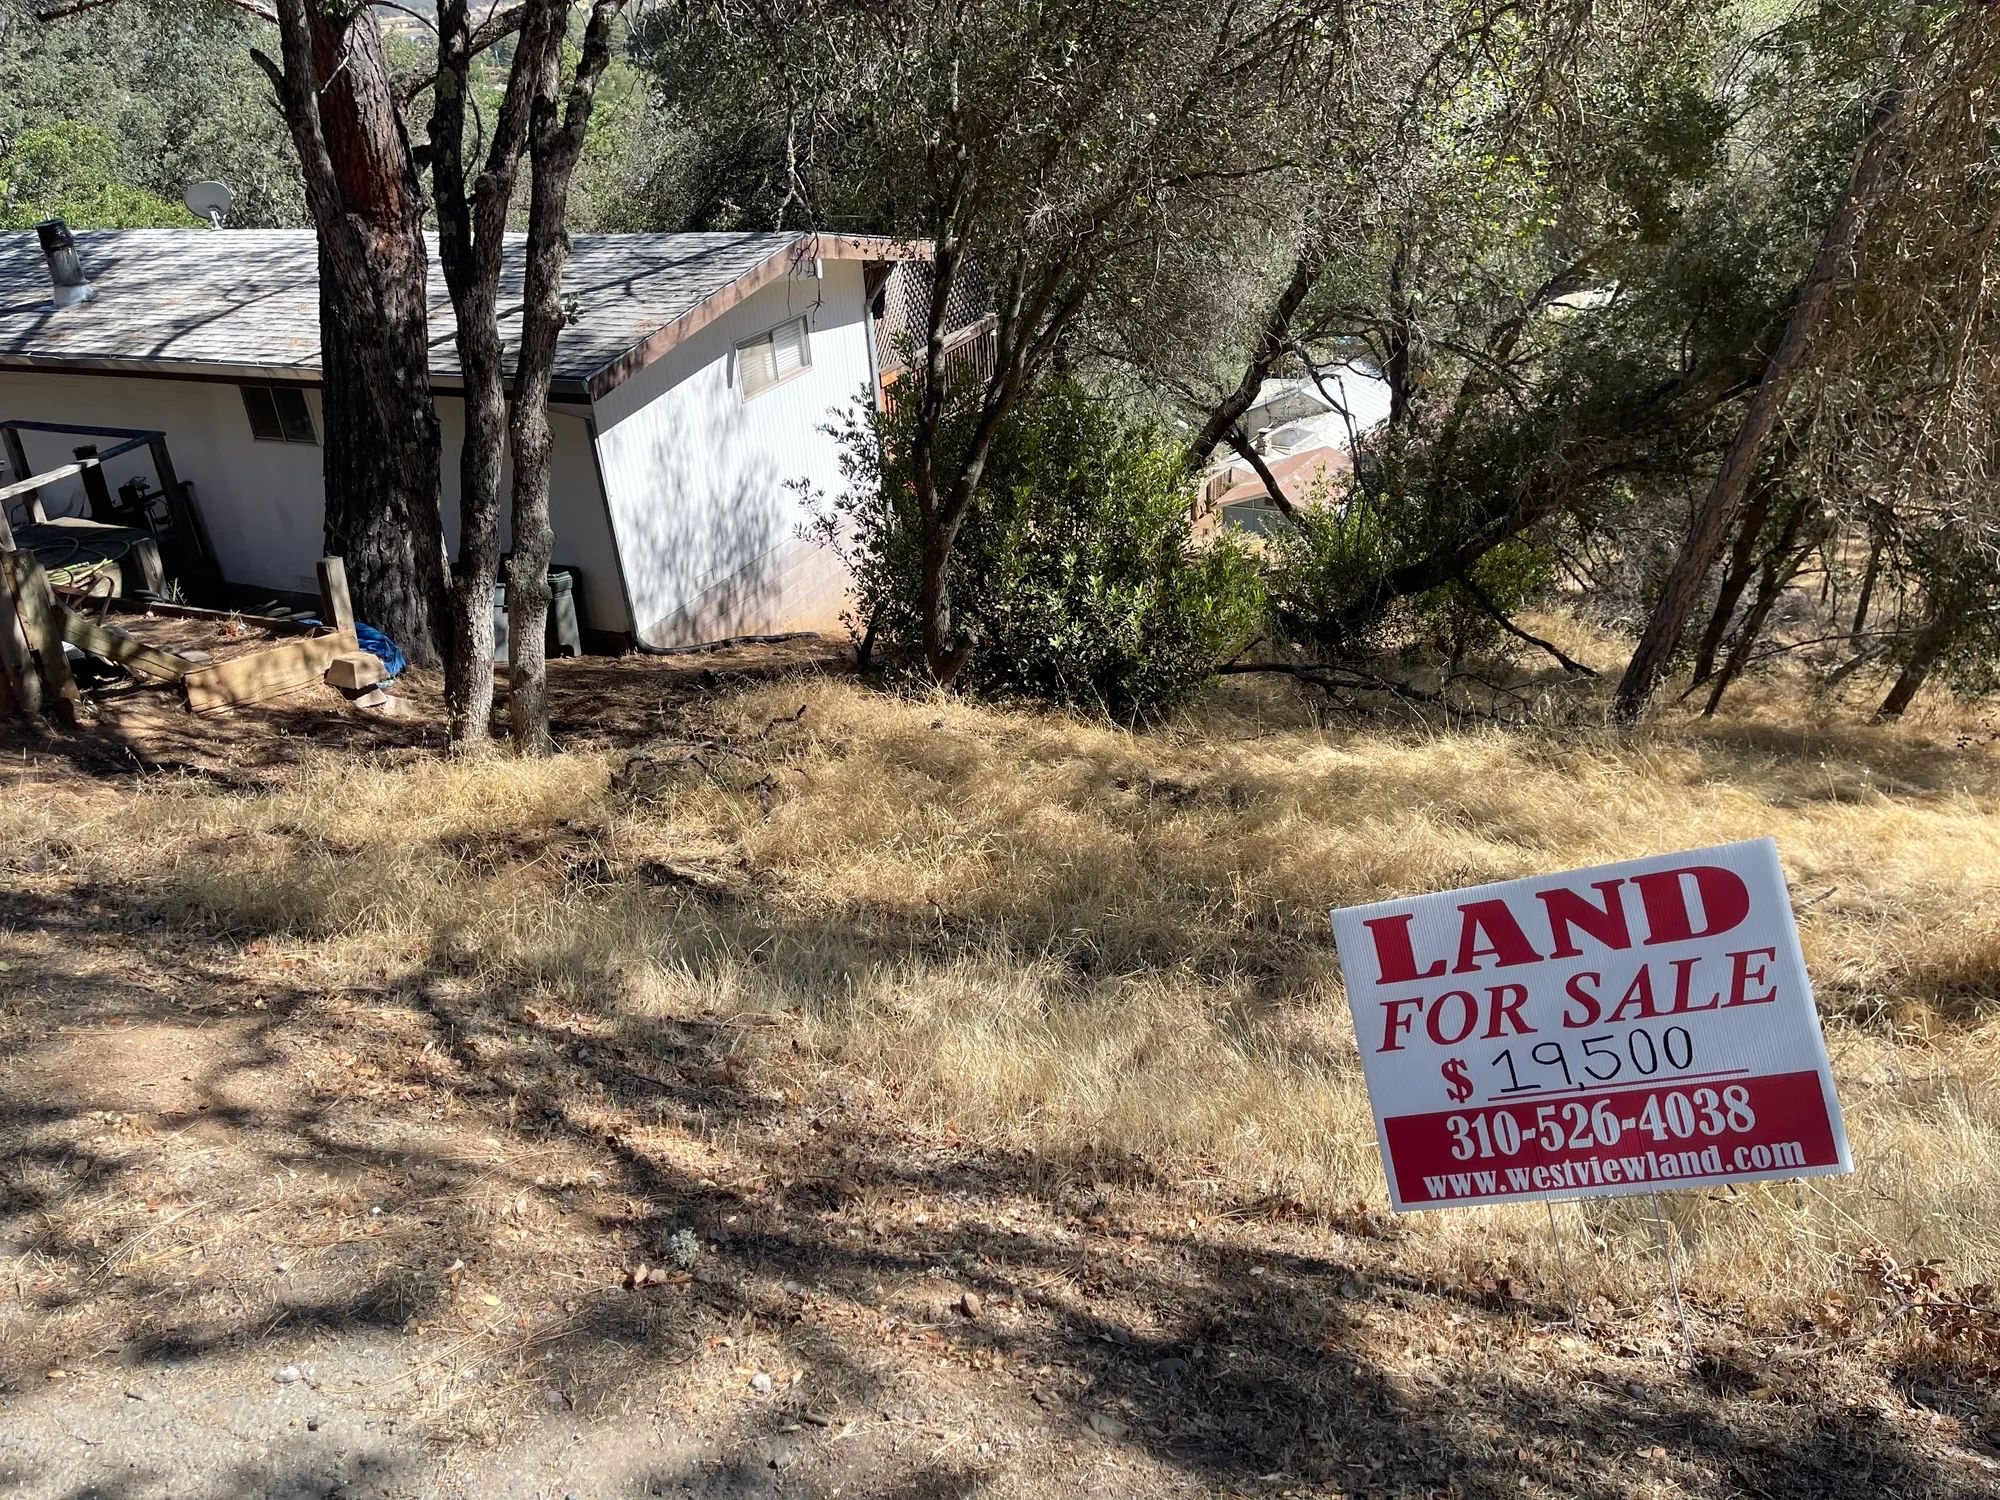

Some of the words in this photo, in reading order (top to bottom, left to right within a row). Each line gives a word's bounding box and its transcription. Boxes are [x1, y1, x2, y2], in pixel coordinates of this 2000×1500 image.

[1363, 865, 1750, 985] LAND
[1376, 982, 1538, 1053] FOR
[1562, 946, 1778, 1029] SALE
[1441, 1057, 1474, 1104] $
[1492, 1026, 1694, 1093] 19,500
[1446, 1084, 1756, 1161] 310-526-4038
[1423, 1138, 1806, 1199] www.westviewland.com
